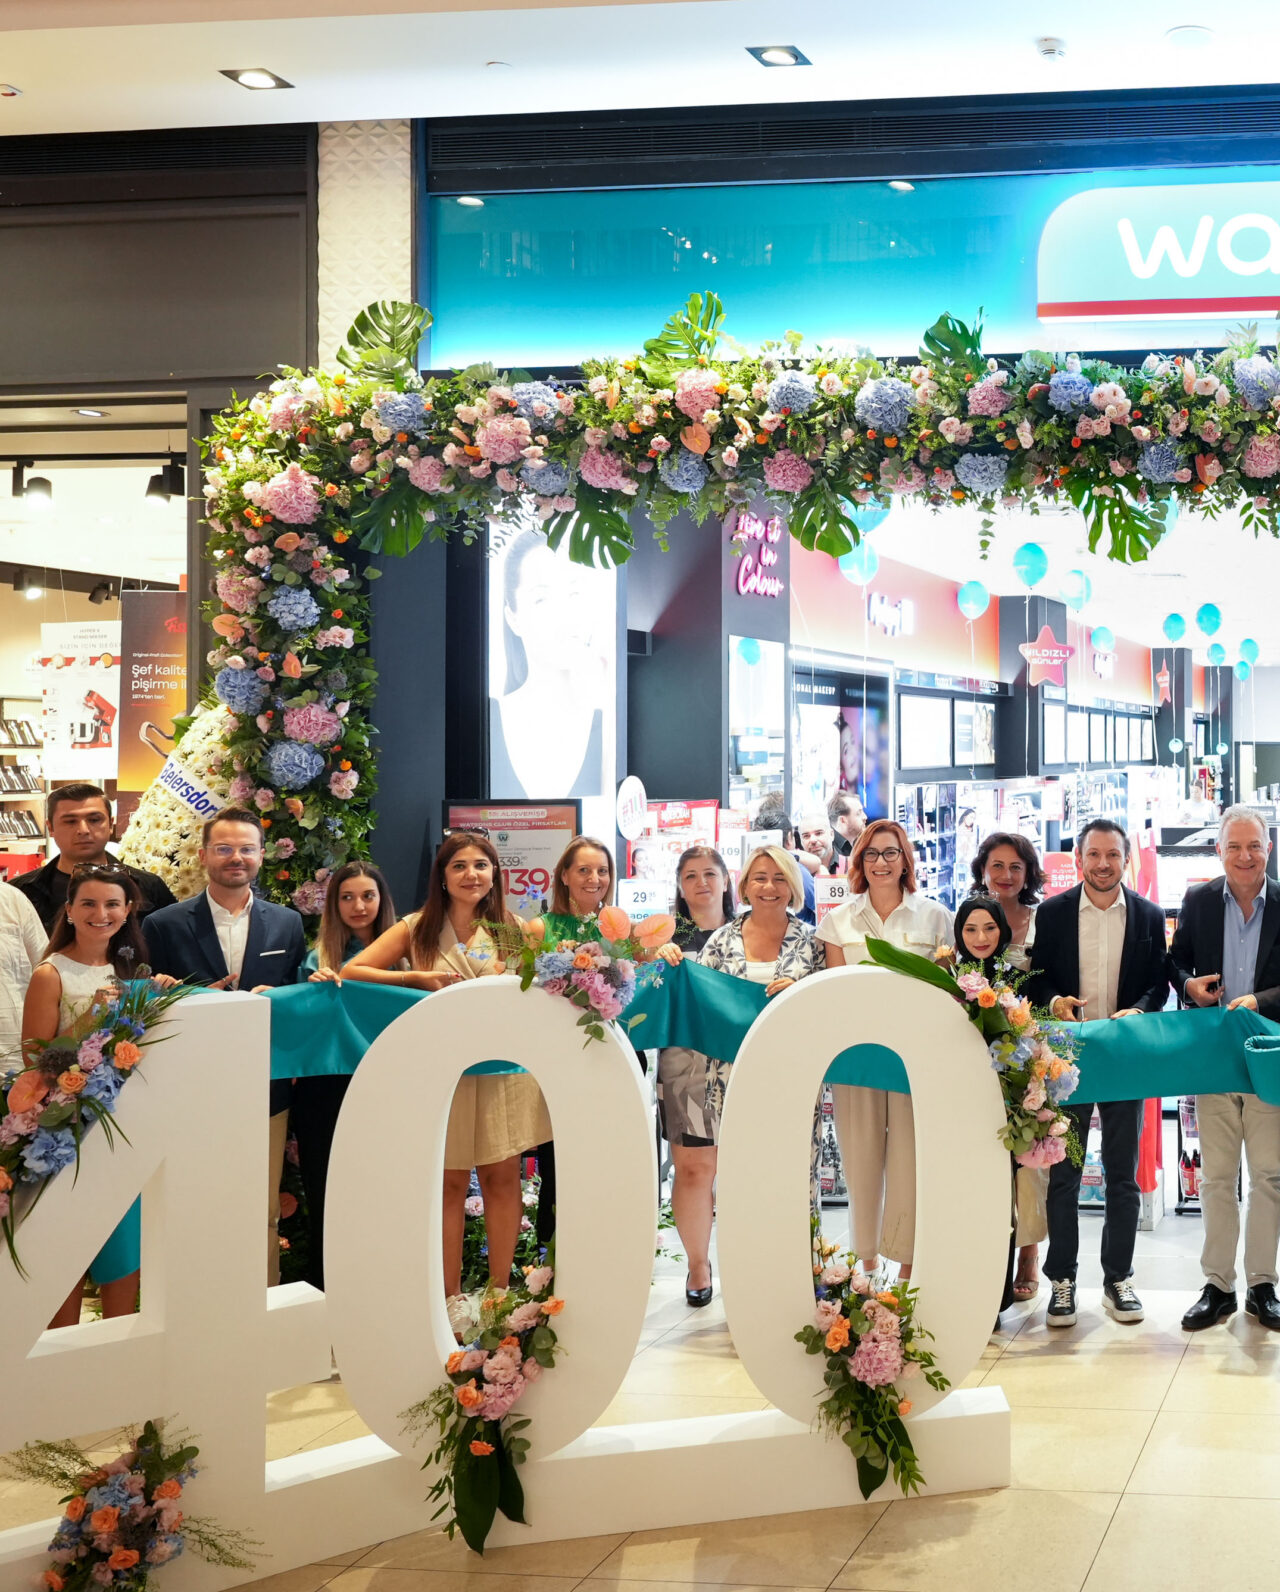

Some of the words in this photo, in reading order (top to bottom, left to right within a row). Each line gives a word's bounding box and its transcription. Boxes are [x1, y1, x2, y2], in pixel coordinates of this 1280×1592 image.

[738, 553, 785, 598] Colour
[131, 664, 152, 678] Şef
[131, 678, 178, 692] pişirme
[721, 847, 740, 857] 109
[498, 856, 521, 867] 339
[501, 868, 550, 896] 139
[632, 891, 648, 903] 29
[829, 886, 845, 898] 89
[0, 963, 1010, 1560] 400
